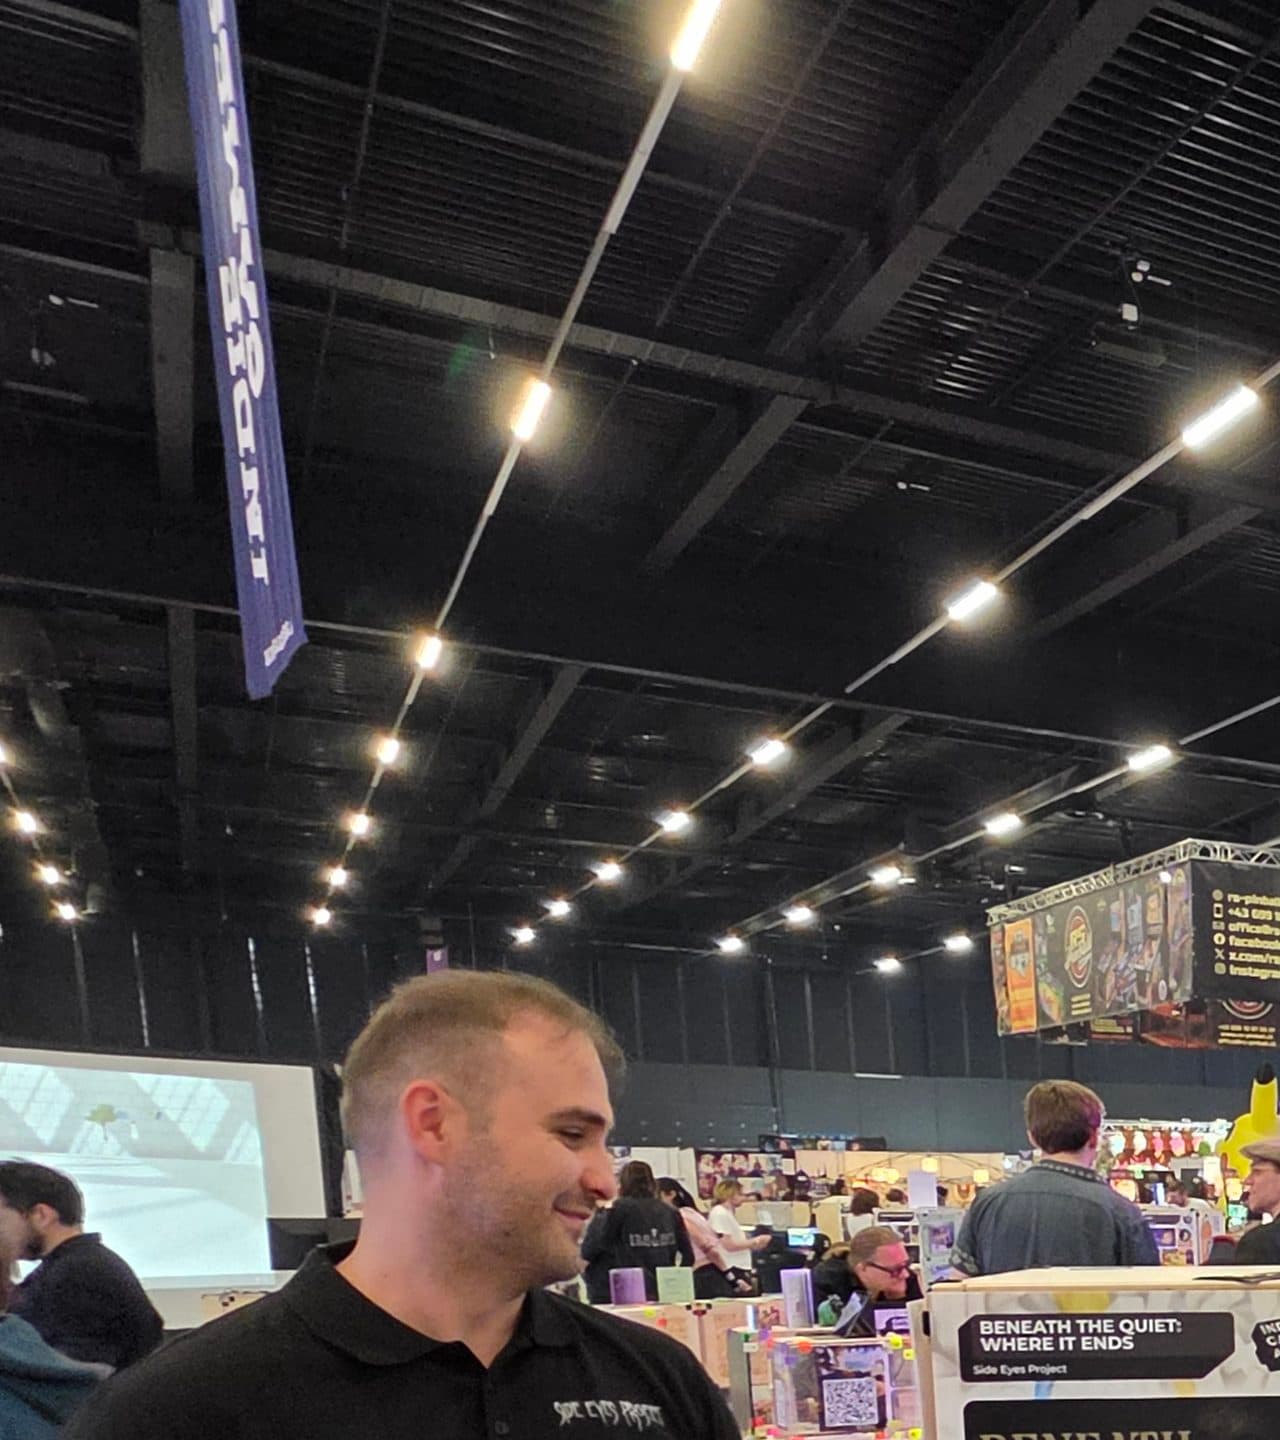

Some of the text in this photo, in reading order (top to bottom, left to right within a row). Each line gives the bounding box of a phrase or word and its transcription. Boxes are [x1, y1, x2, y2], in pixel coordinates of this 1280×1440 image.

[979, 1318, 1182, 1336] BENEATH THE QUIET:
[979, 1335, 1135, 1352] WHERE IT ENDS
[972, 1364, 1067, 1376] Side Eyes Project
